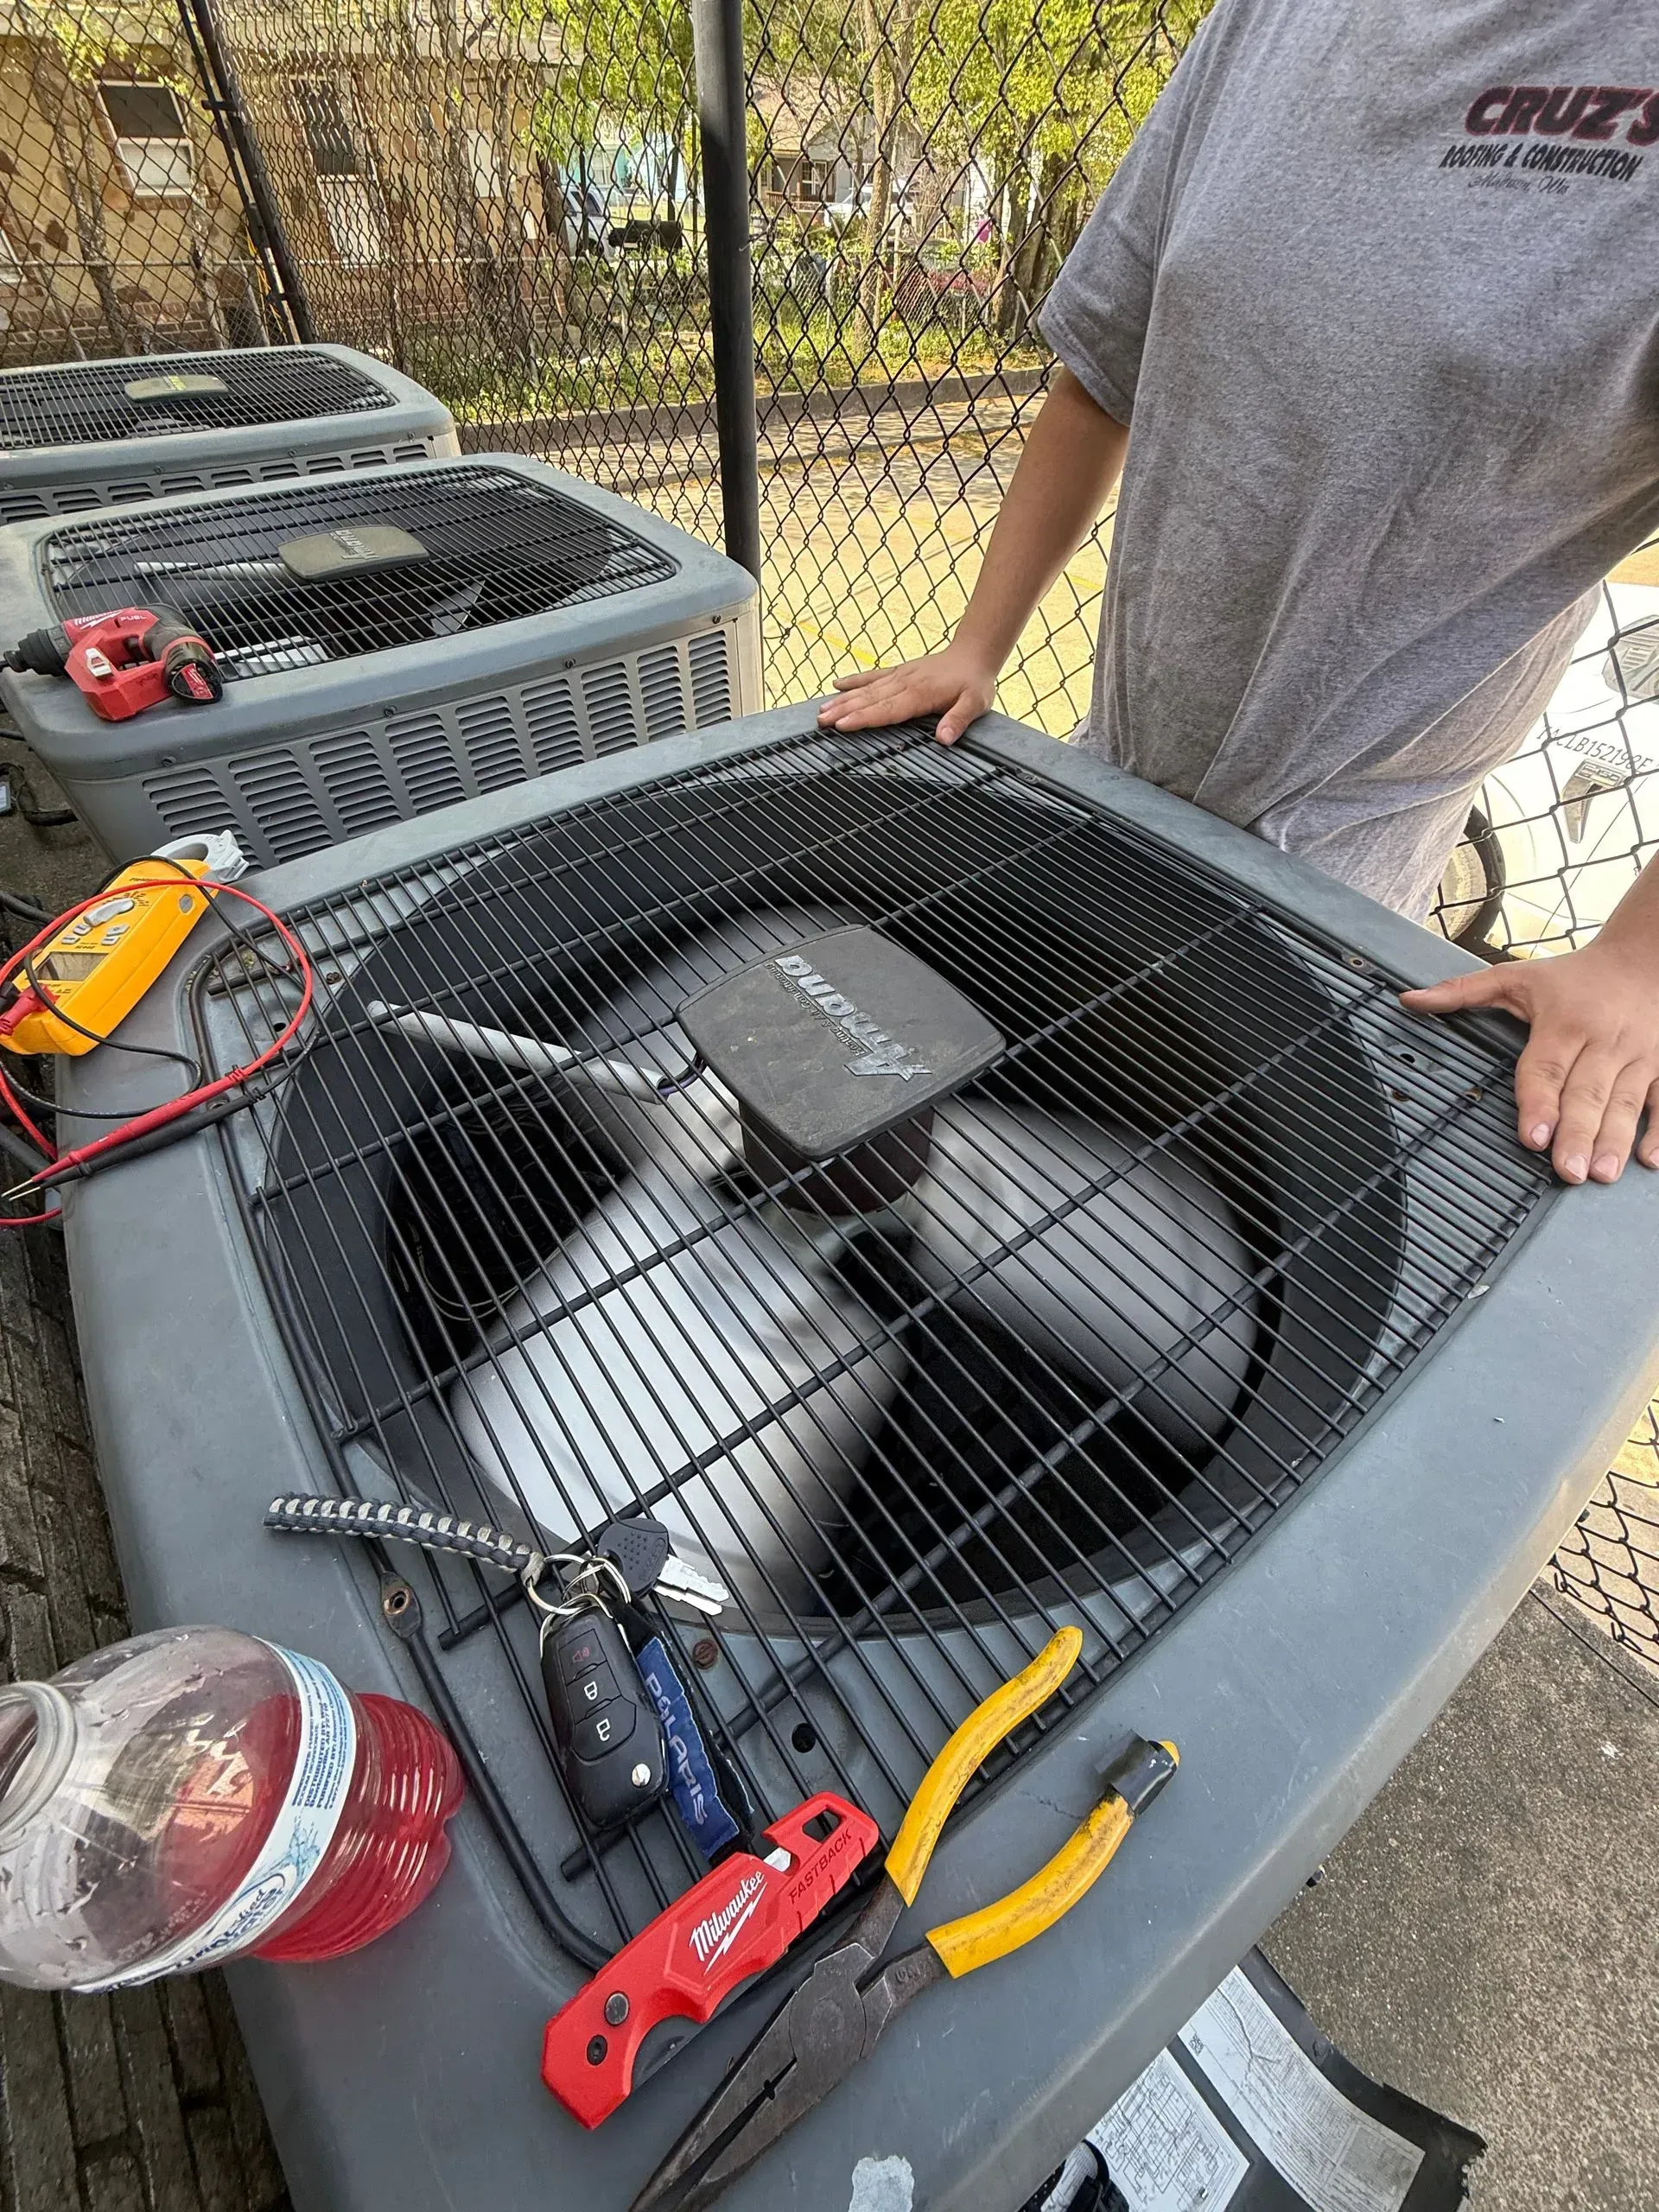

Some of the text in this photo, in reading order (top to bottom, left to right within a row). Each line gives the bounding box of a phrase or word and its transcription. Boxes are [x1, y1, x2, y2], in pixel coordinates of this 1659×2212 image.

[1439, 143, 1644, 182] ROOFING & CONSTRUCTION
[763, 963, 812, 1009] Conditioning
[810, 1008, 828, 1020] Air
[773, 955, 933, 1081] Amana
[830, 1027, 867, 1057] Heating
[645, 1672, 708, 1826] POLARIS
[787, 1827, 854, 1905] FASTBACK
[688, 1869, 766, 1962] Milwaukee
